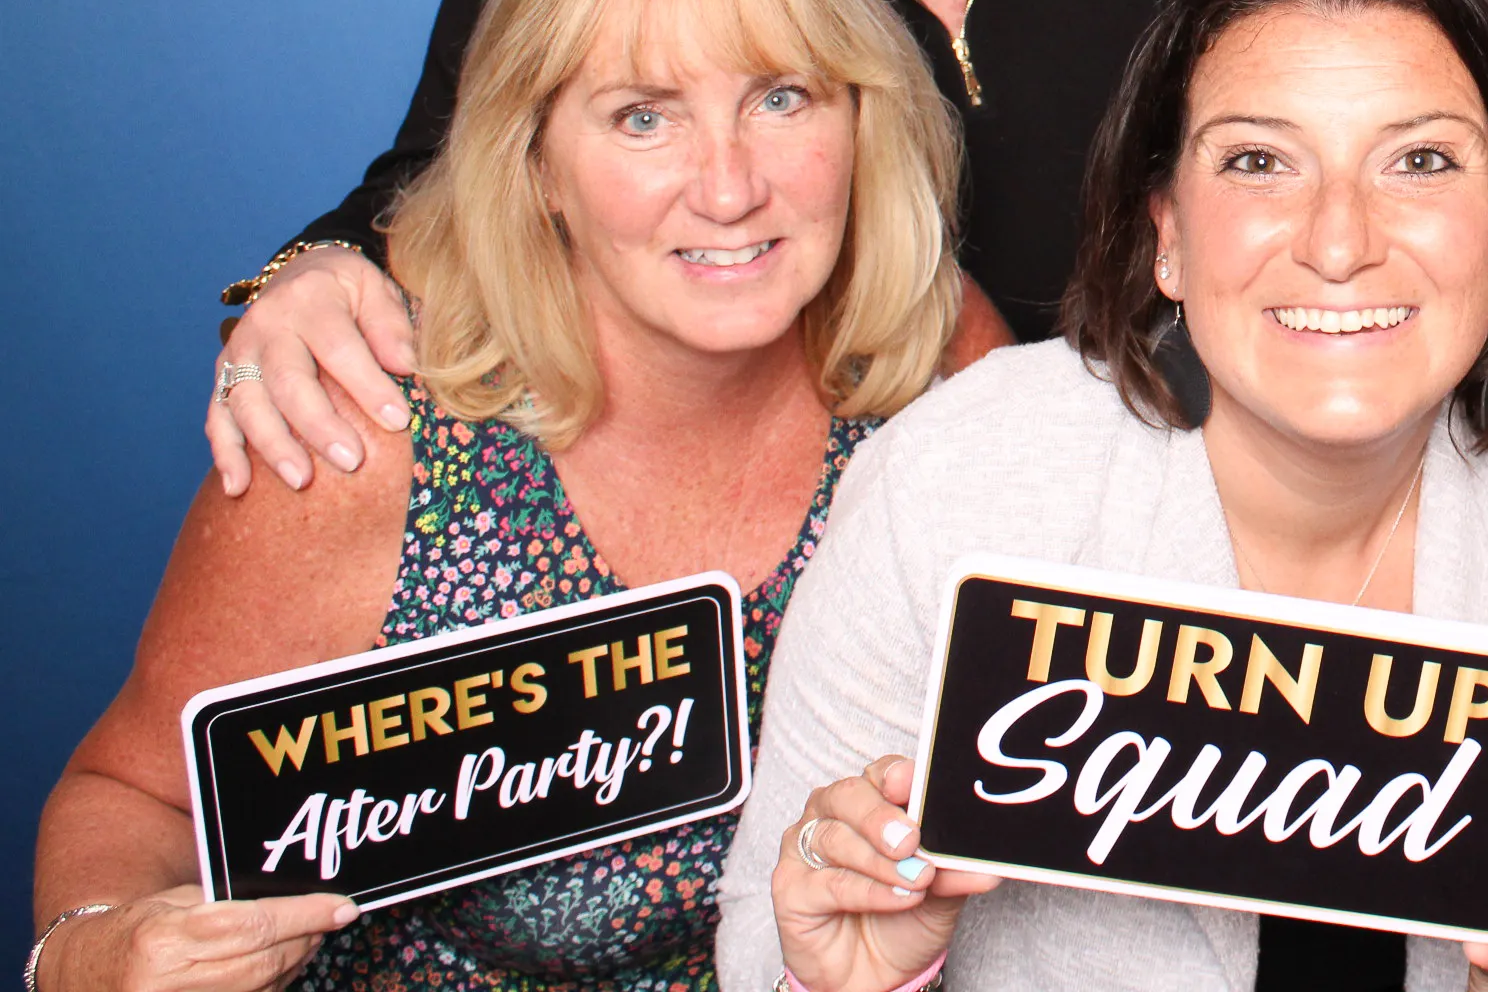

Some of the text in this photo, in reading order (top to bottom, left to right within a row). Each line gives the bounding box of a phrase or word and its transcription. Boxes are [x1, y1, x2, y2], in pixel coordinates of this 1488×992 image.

[248, 624, 690, 777] WHERE'S THE
[1011, 599, 1324, 724] TURN
[261, 698, 693, 879] After Party?!
[973, 679, 1481, 865] Squad
